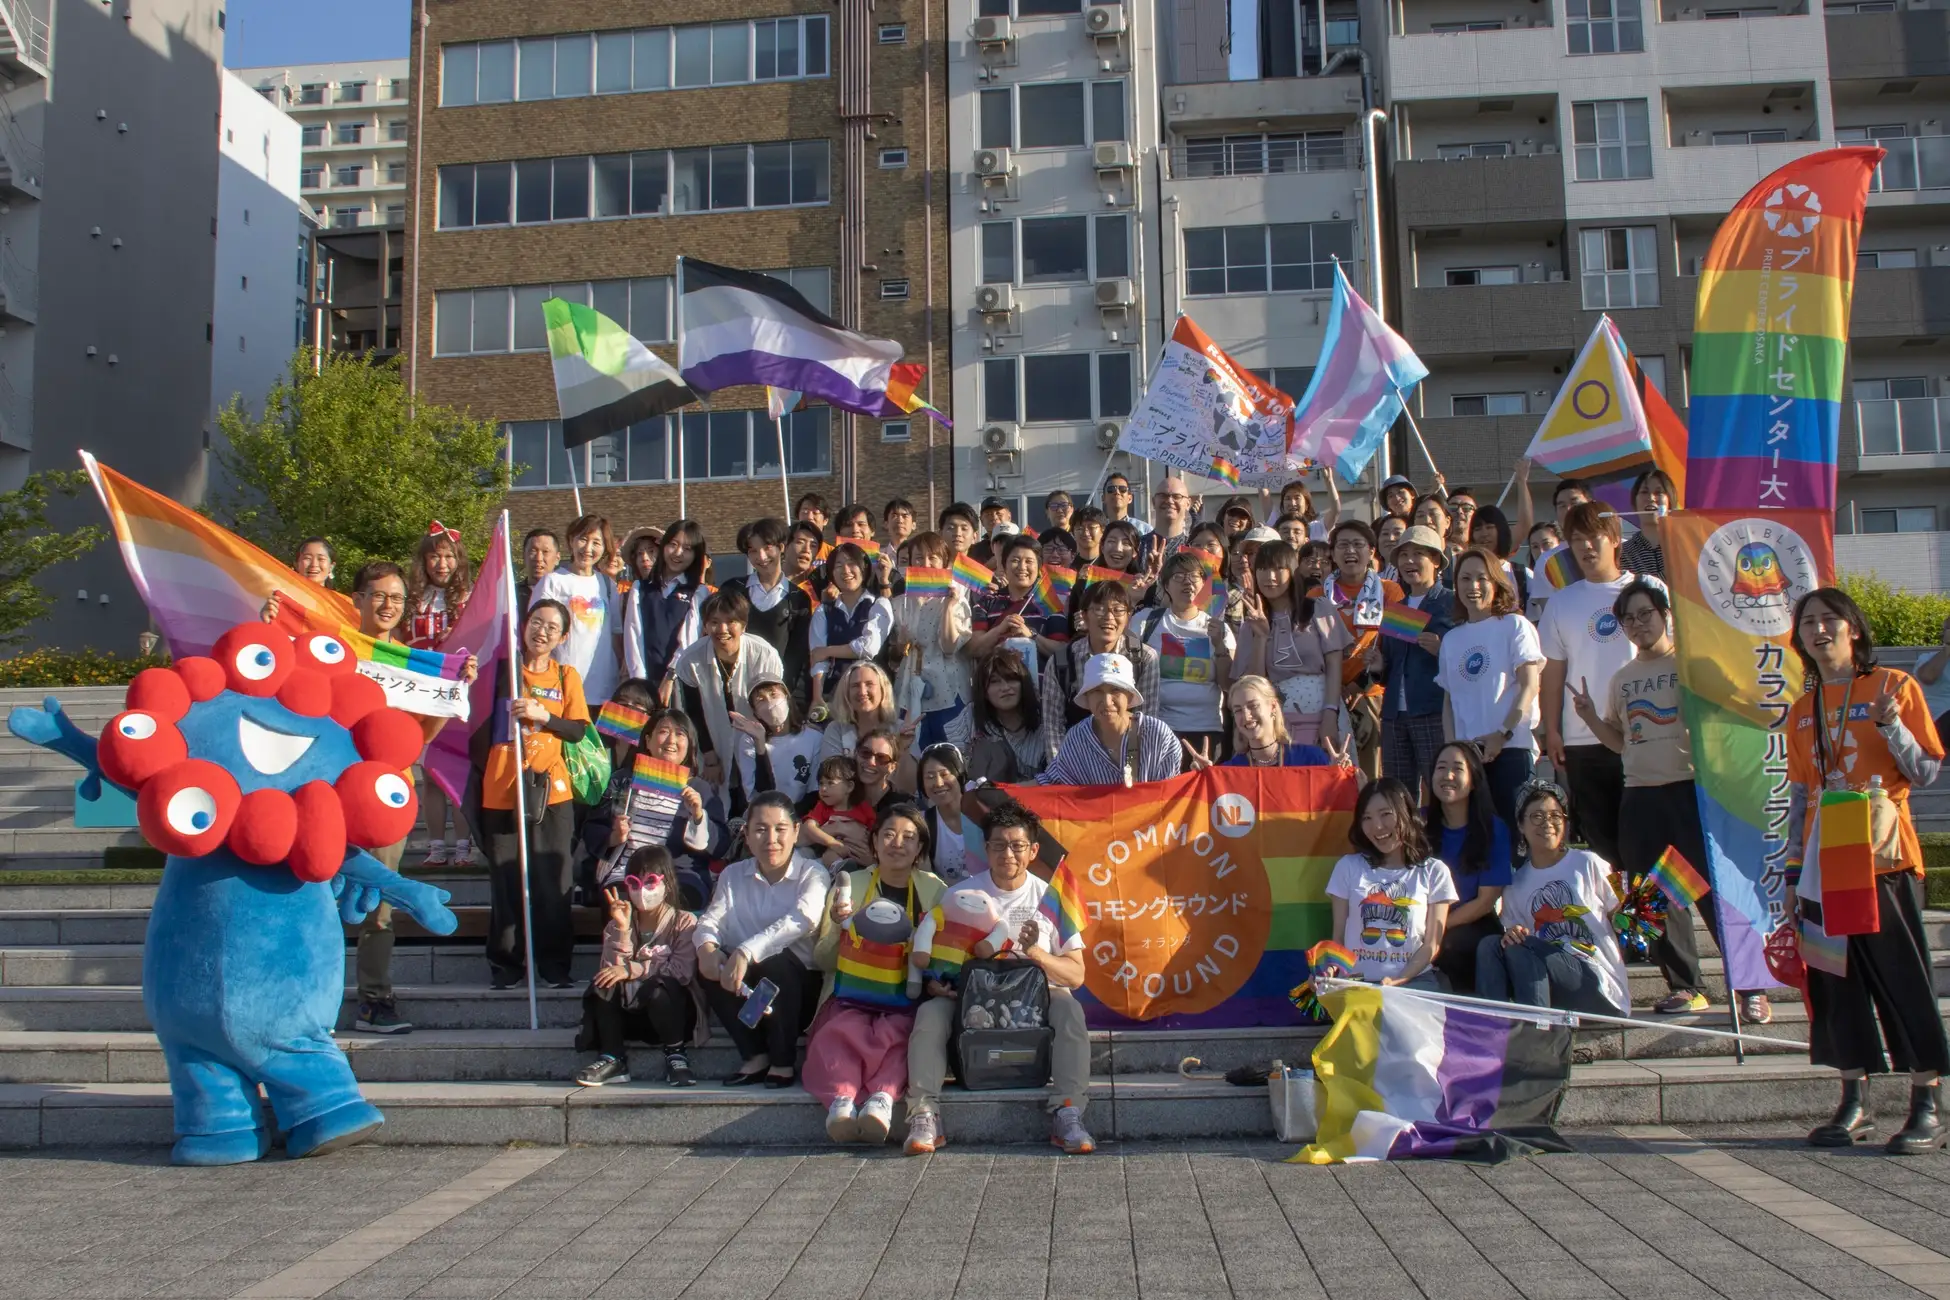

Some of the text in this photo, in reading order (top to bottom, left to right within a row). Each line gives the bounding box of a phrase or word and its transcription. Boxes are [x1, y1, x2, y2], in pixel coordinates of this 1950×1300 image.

[1760, 248, 1774, 280] PRIDE
[1754, 330, 1766, 365] OSAKA
[1759, 246, 1811, 509] プライドセンター大
[1160, 449, 1194, 470] PRIDE
[1708, 530, 1745, 620] COLORFUL
[531, 687, 547, 697] FOR
[1621, 673, 1678, 698] STAFF
[1217, 804, 1251, 826] NL
[1088, 821, 1238, 887] COMMON
[1086, 892, 1248, 921] コモングラウンド
[1093, 934, 1239, 998] GROUND
[1352, 948, 1388, 963] PROUD
